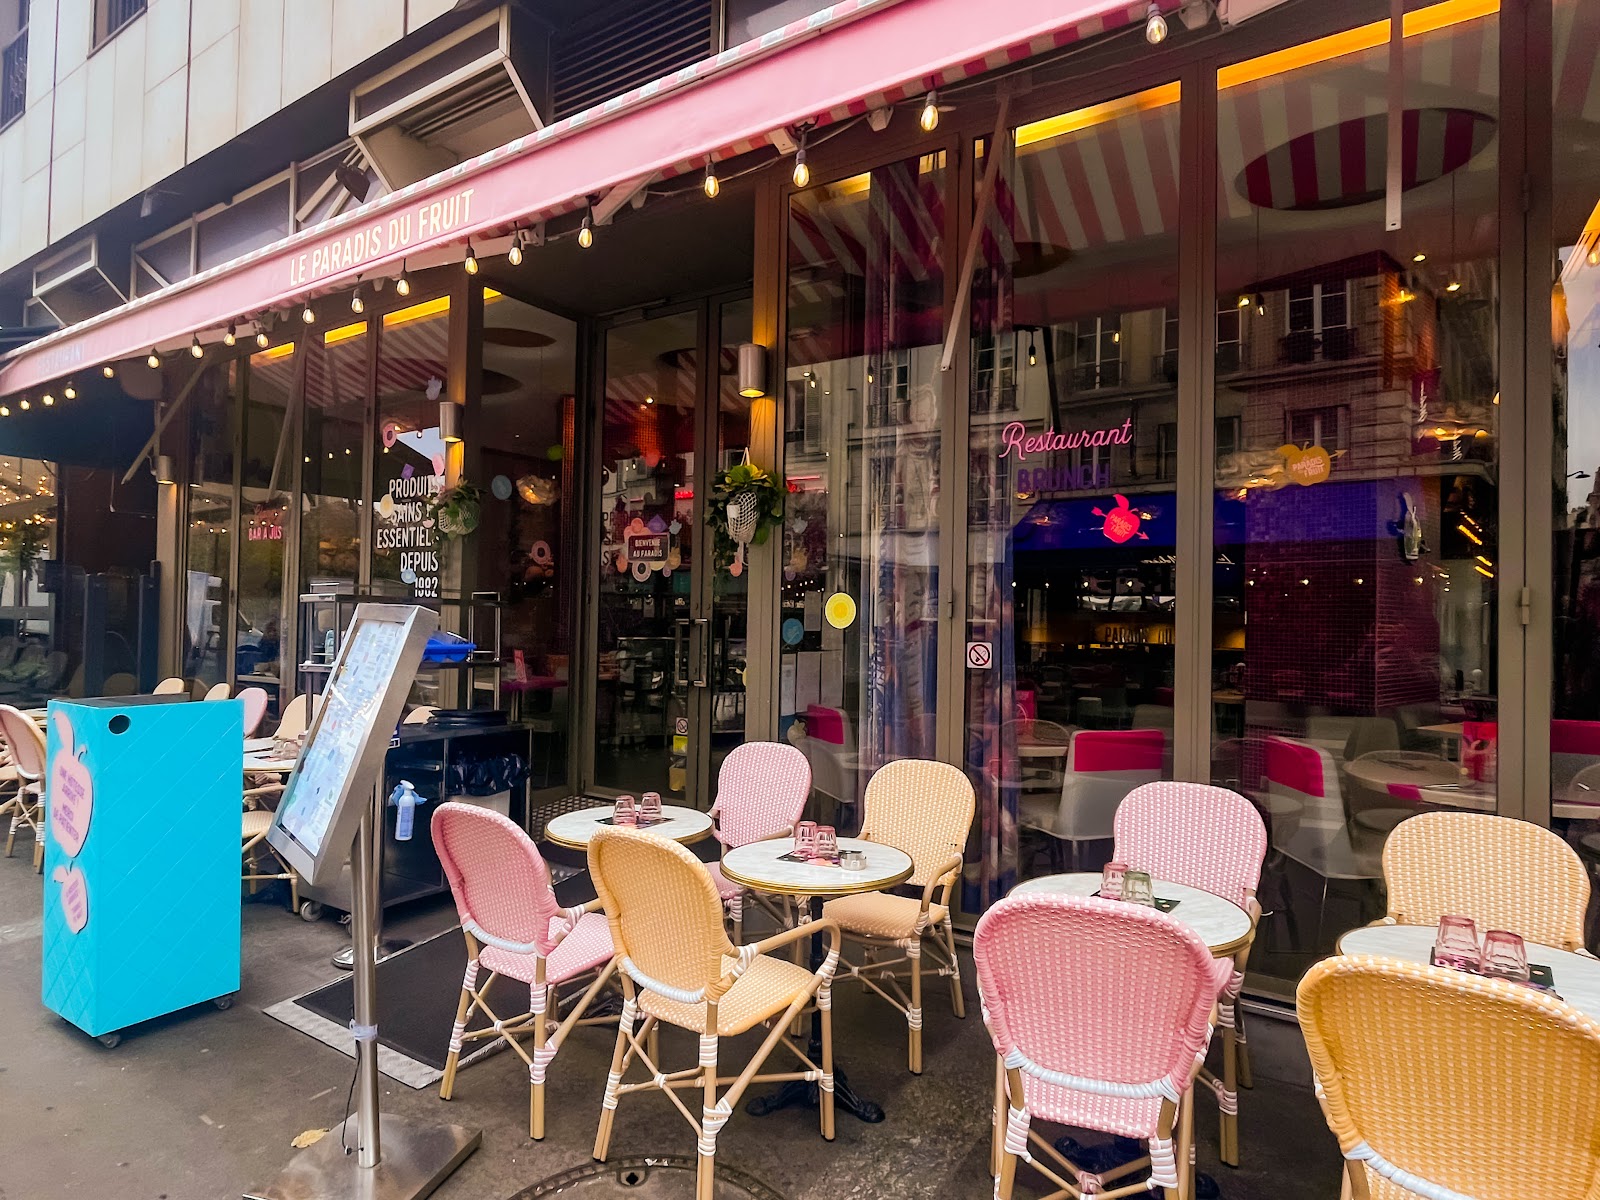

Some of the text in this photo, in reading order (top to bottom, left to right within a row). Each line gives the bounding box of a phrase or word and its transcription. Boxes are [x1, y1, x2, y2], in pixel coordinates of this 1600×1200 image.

[289, 188, 475, 287] LE PARADIS DU FRUIT
[998, 417, 1133, 461] Restaurant
[1017, 463, 1111, 493] BRUNCH
[269, 525, 282, 540] JUS
[376, 526, 439, 549] ESSENTIEL
[400, 551, 439, 572] DEPUIS
[640, 549, 663, 558] PARADIS
